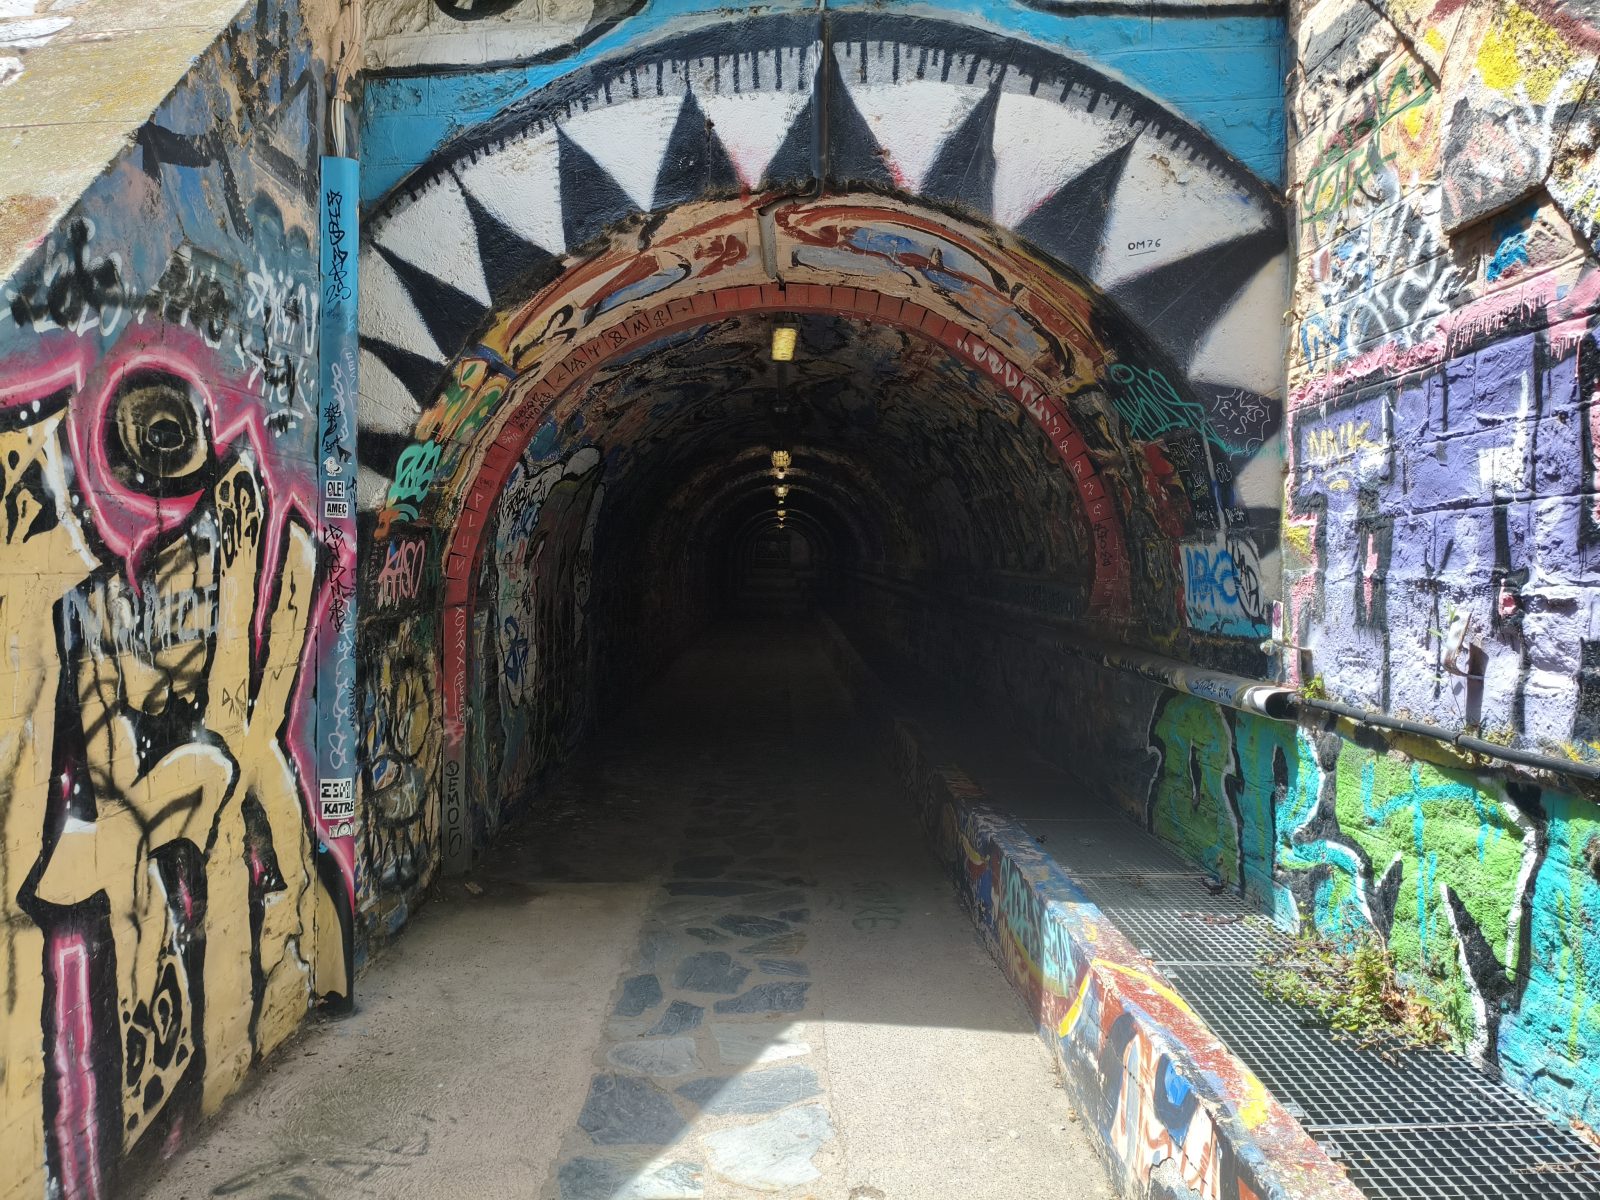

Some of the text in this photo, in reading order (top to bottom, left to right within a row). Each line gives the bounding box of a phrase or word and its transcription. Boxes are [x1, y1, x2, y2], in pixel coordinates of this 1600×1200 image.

[1128, 238, 1162, 251] OM76
[326, 502, 347, 514] AMEC
[324, 801, 354, 814] KATRE
